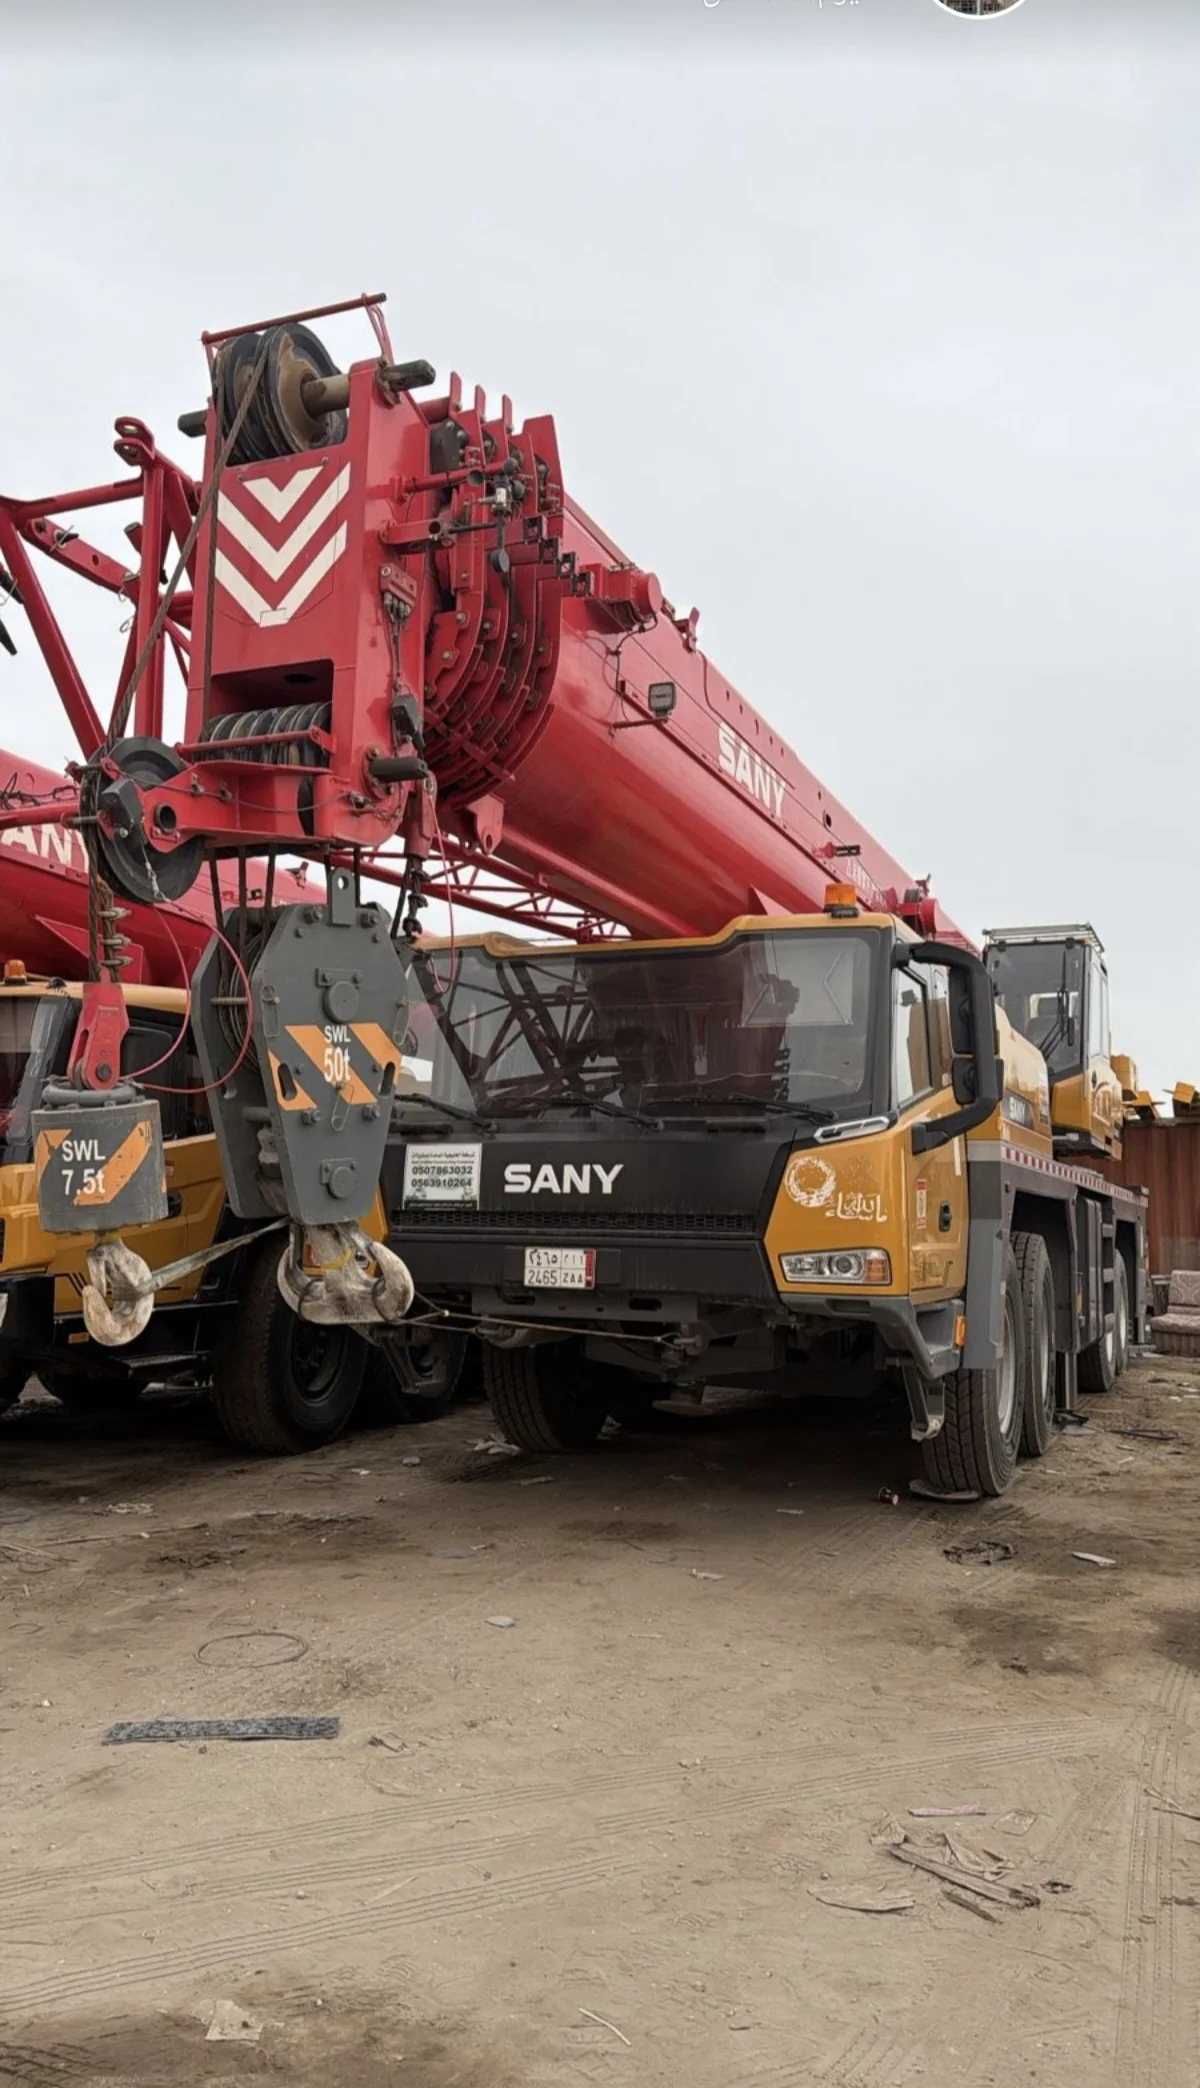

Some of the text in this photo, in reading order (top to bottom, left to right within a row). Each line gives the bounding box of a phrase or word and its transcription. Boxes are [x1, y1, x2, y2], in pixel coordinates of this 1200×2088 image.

[718, 722, 786, 818] SANY
[324, 1024, 351, 1043] SWL
[324, 1046, 351, 1082] 50t
[62, 1139, 106, 1162] SWL
[61, 1168, 106, 1195] 7.5t
[412, 1166, 473, 1175] 0507863032
[503, 1163, 624, 1194] SANY
[528, 1269, 584, 1285] 2465 ZAA
